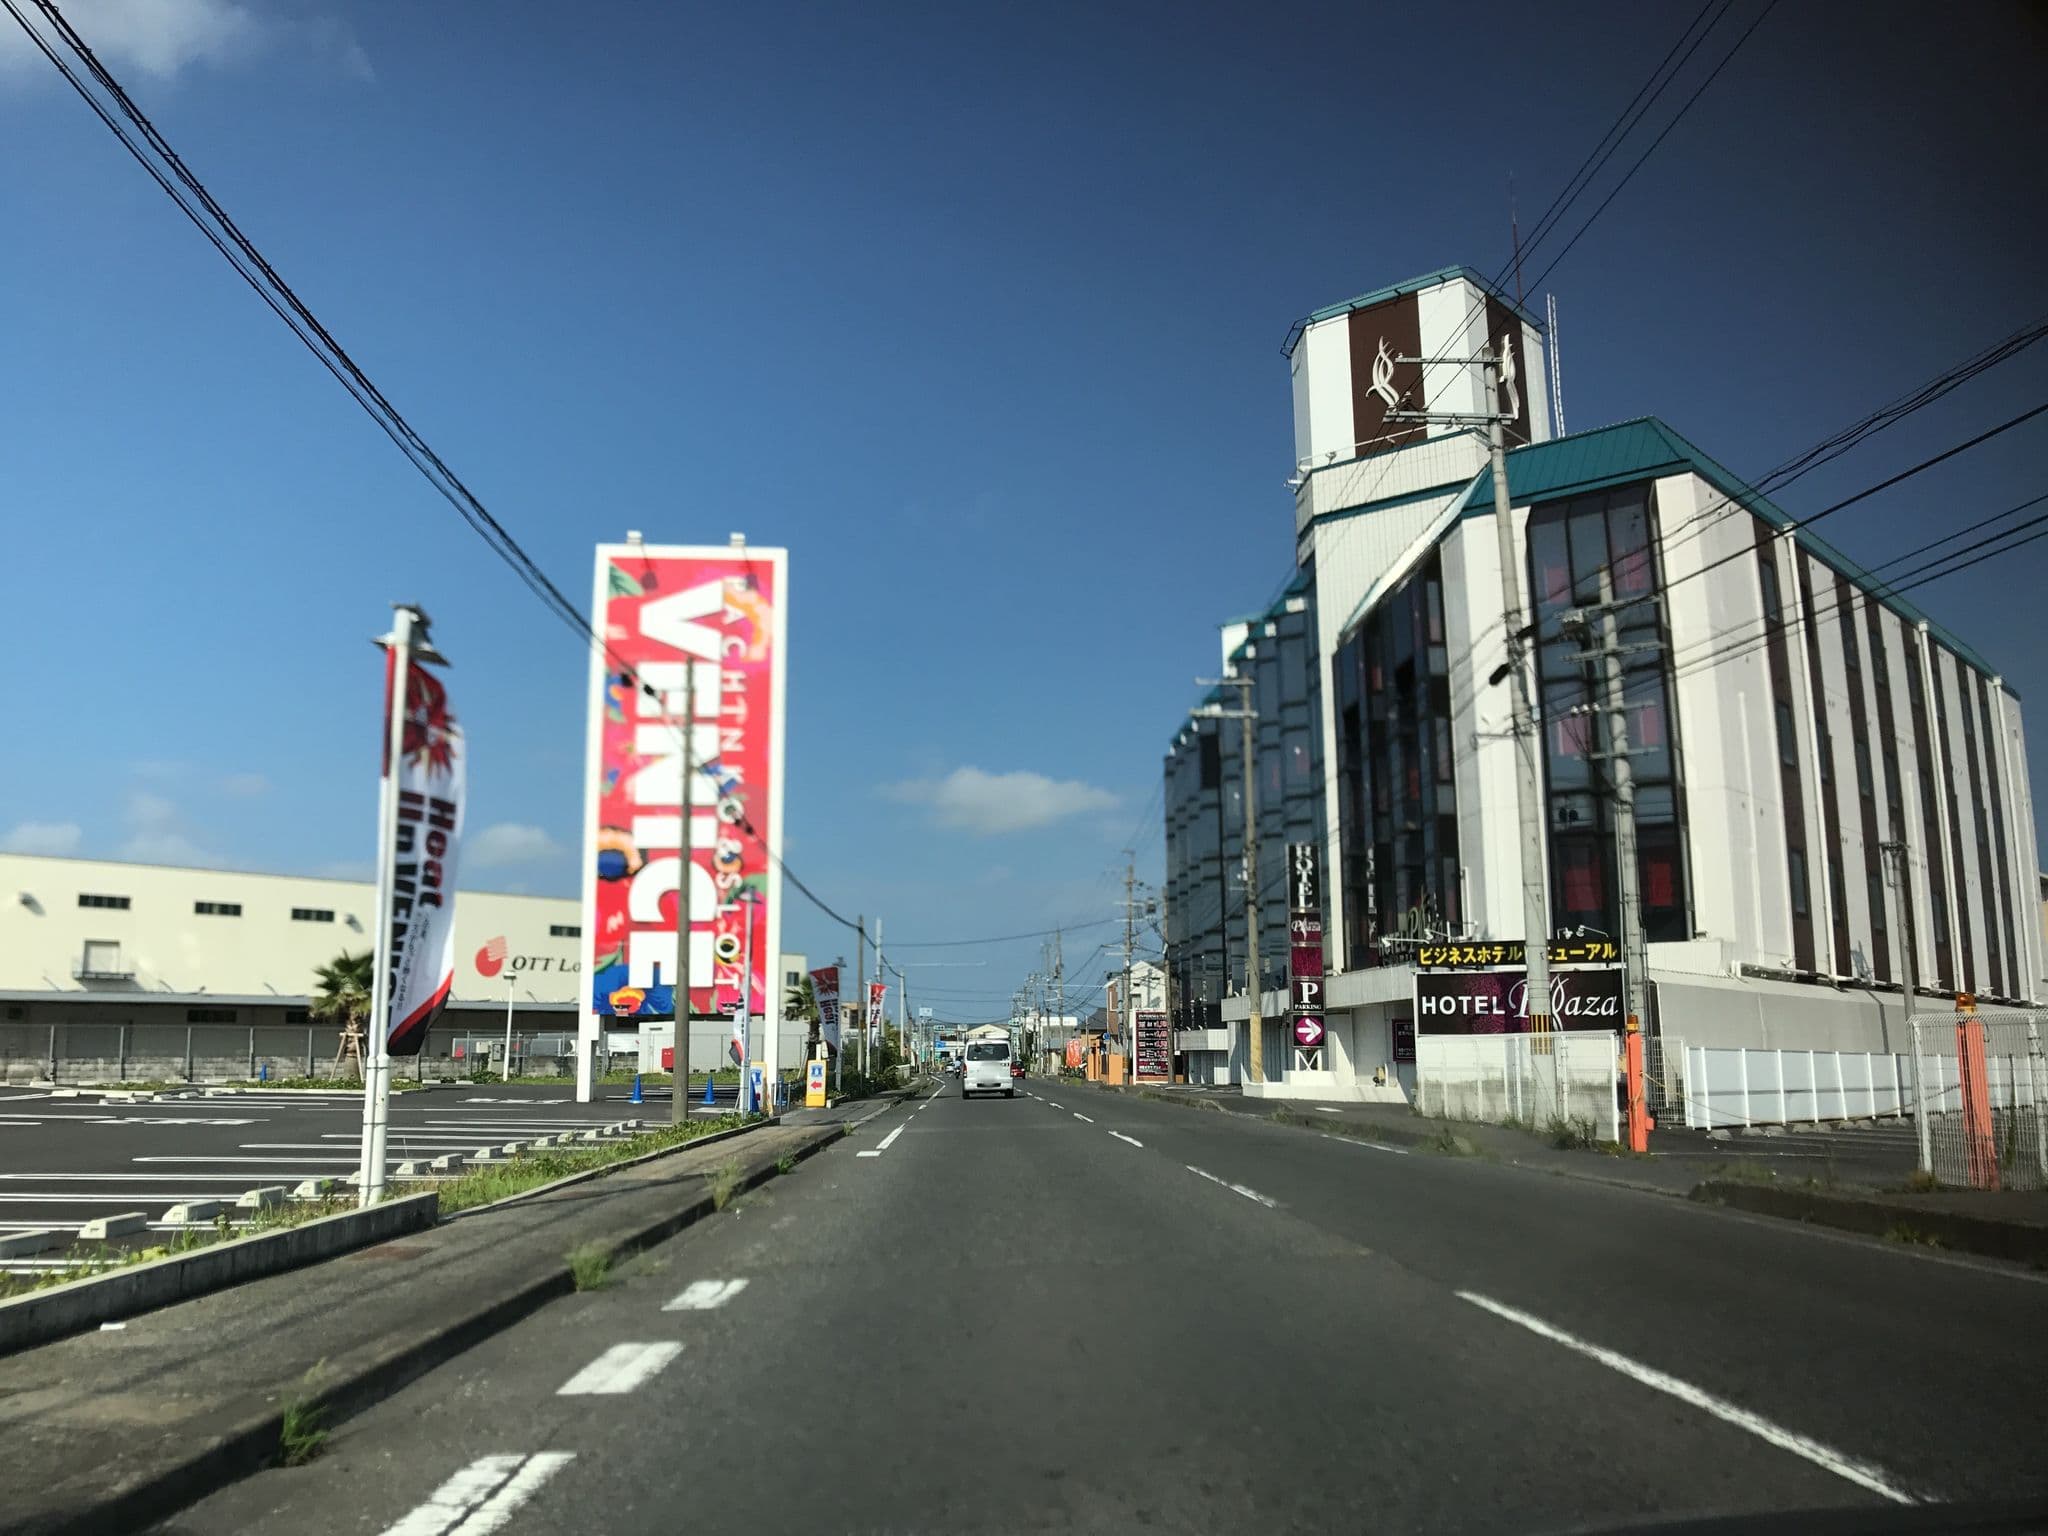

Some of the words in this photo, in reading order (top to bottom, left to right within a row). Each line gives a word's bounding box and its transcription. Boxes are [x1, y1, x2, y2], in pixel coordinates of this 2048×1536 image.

[628, 578, 724, 988] VENICE
[1295, 844, 1313, 908] HOTEL
[512, 955, 554, 971] OTT
[1420, 943, 1617, 965] ビジネスホテルューアル
[1300, 982, 1319, 1004] P
[1422, 996, 1505, 1014] HOTEL
